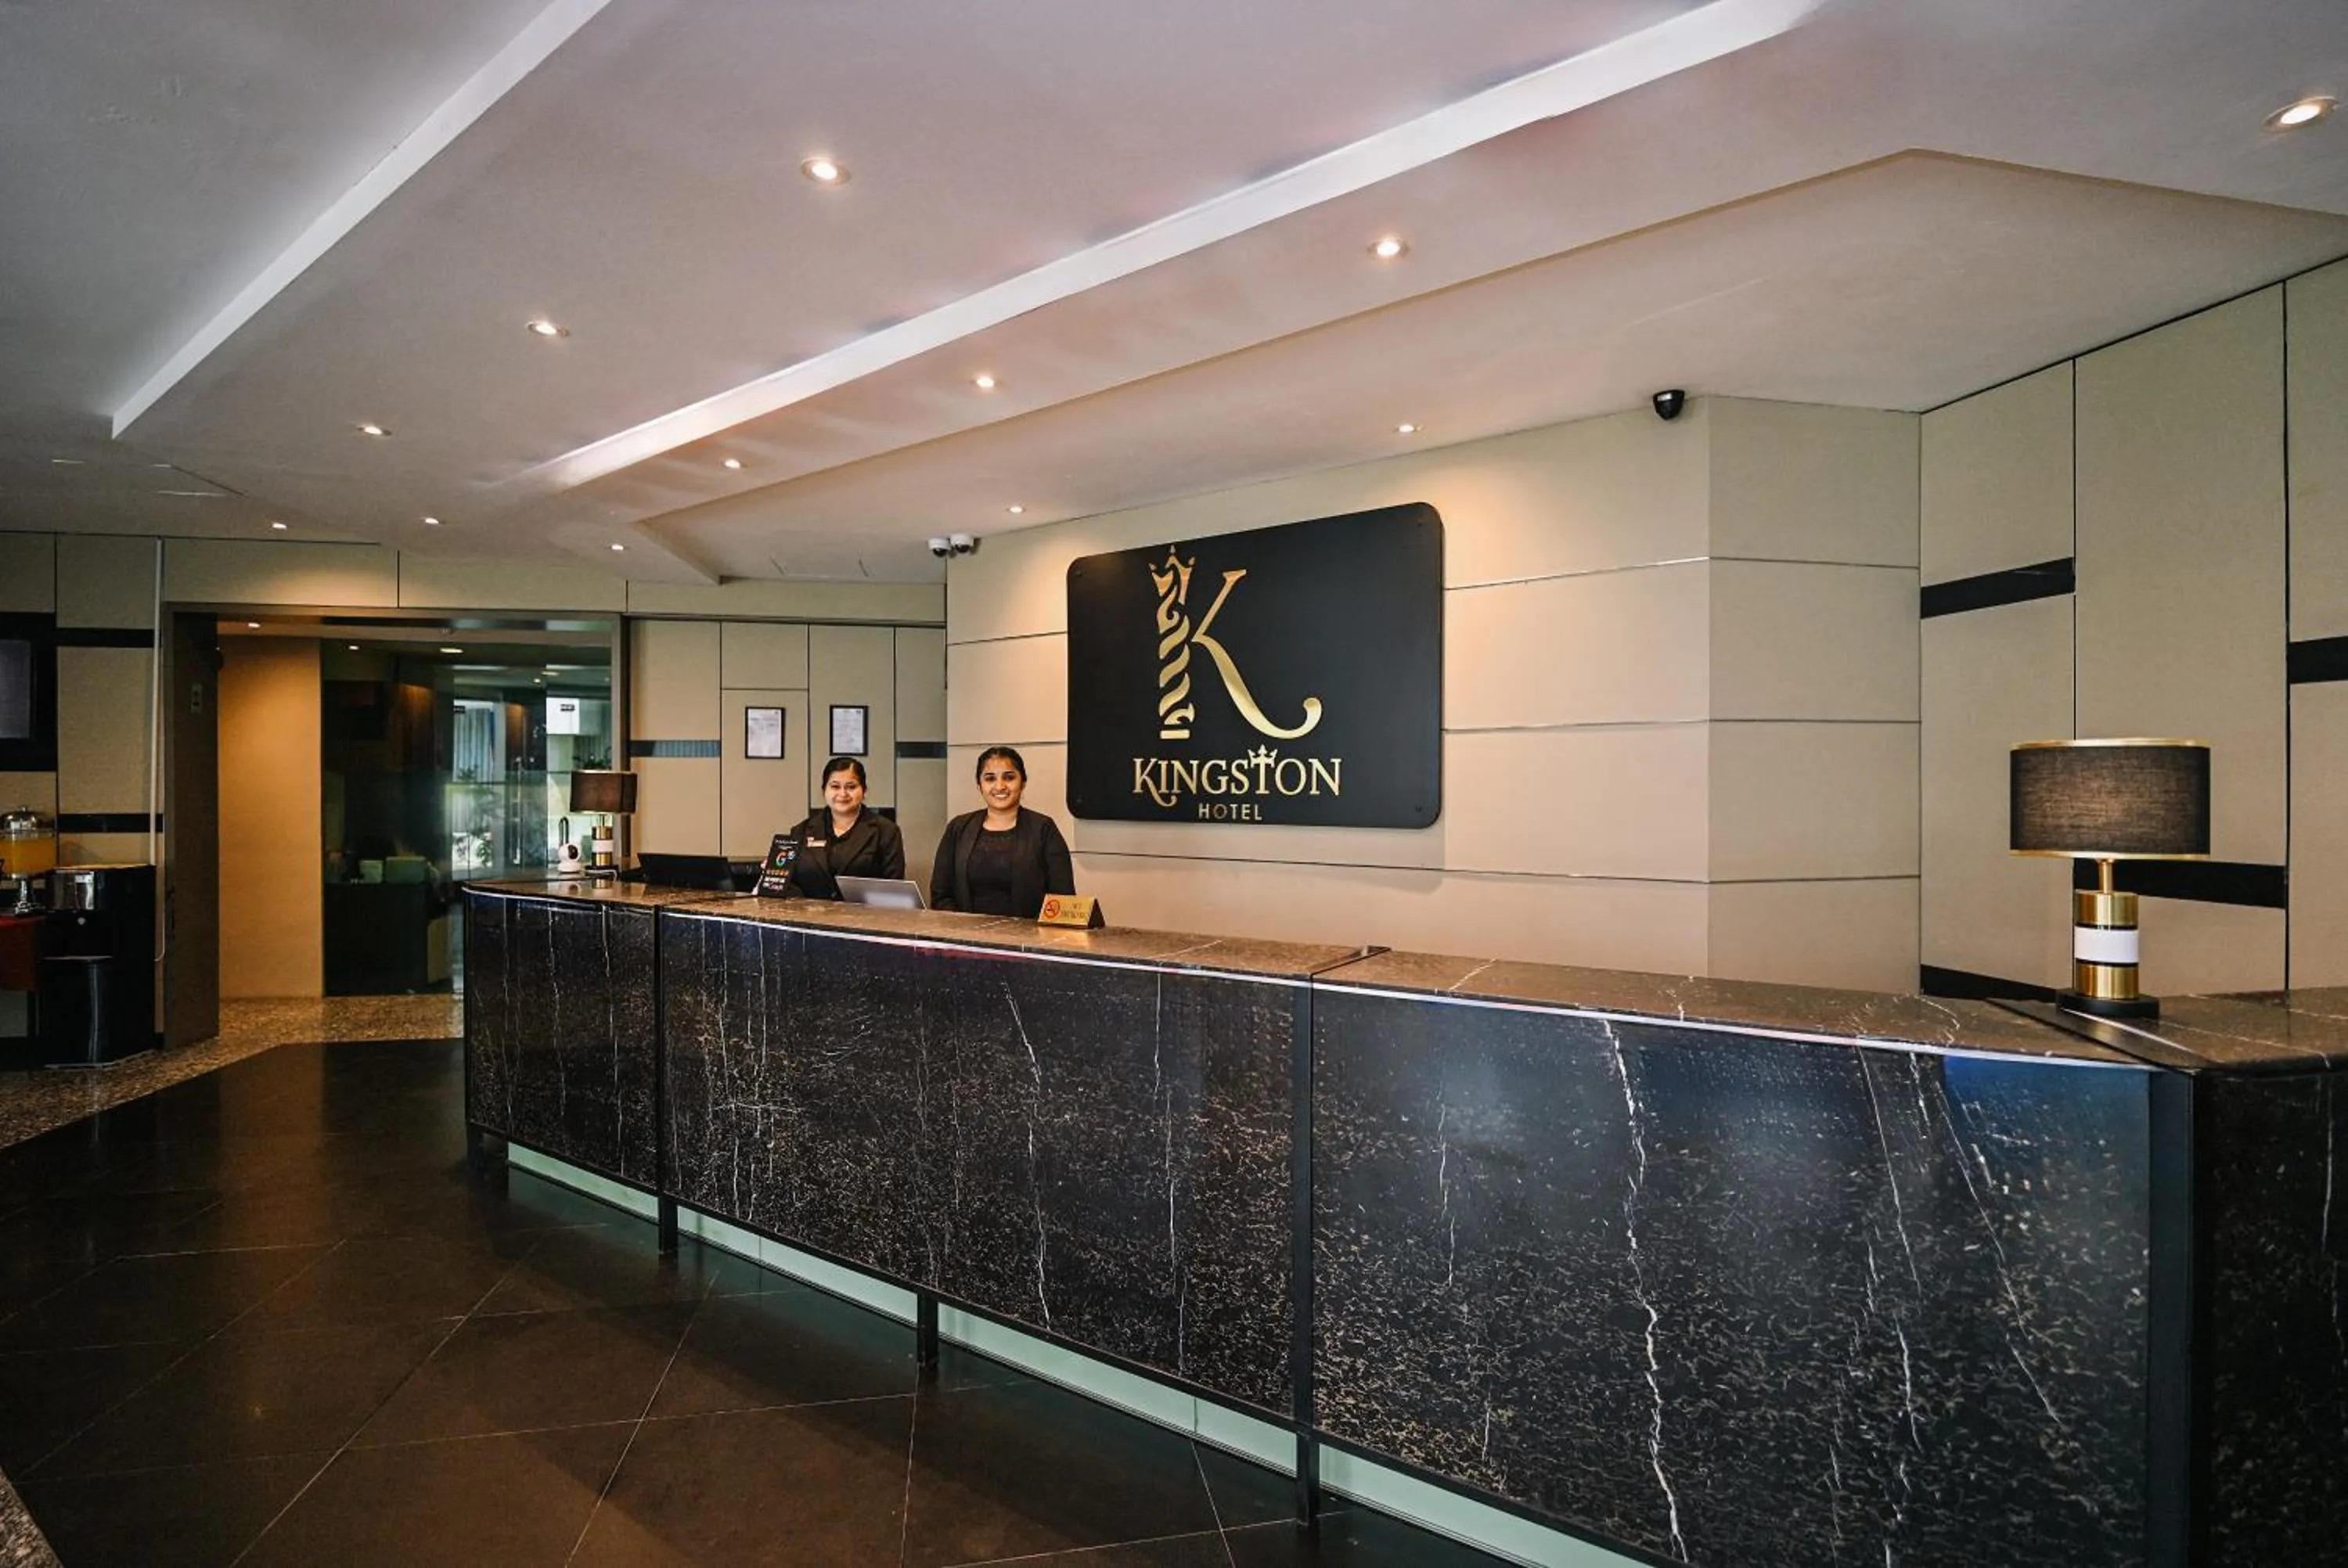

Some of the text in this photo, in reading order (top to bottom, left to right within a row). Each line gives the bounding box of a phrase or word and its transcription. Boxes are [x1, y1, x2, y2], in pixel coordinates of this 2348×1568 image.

[1150, 545, 1323, 739] K
[1133, 757, 1342, 807] KINGSTON
[1198, 804, 1263, 821] HOTEL
